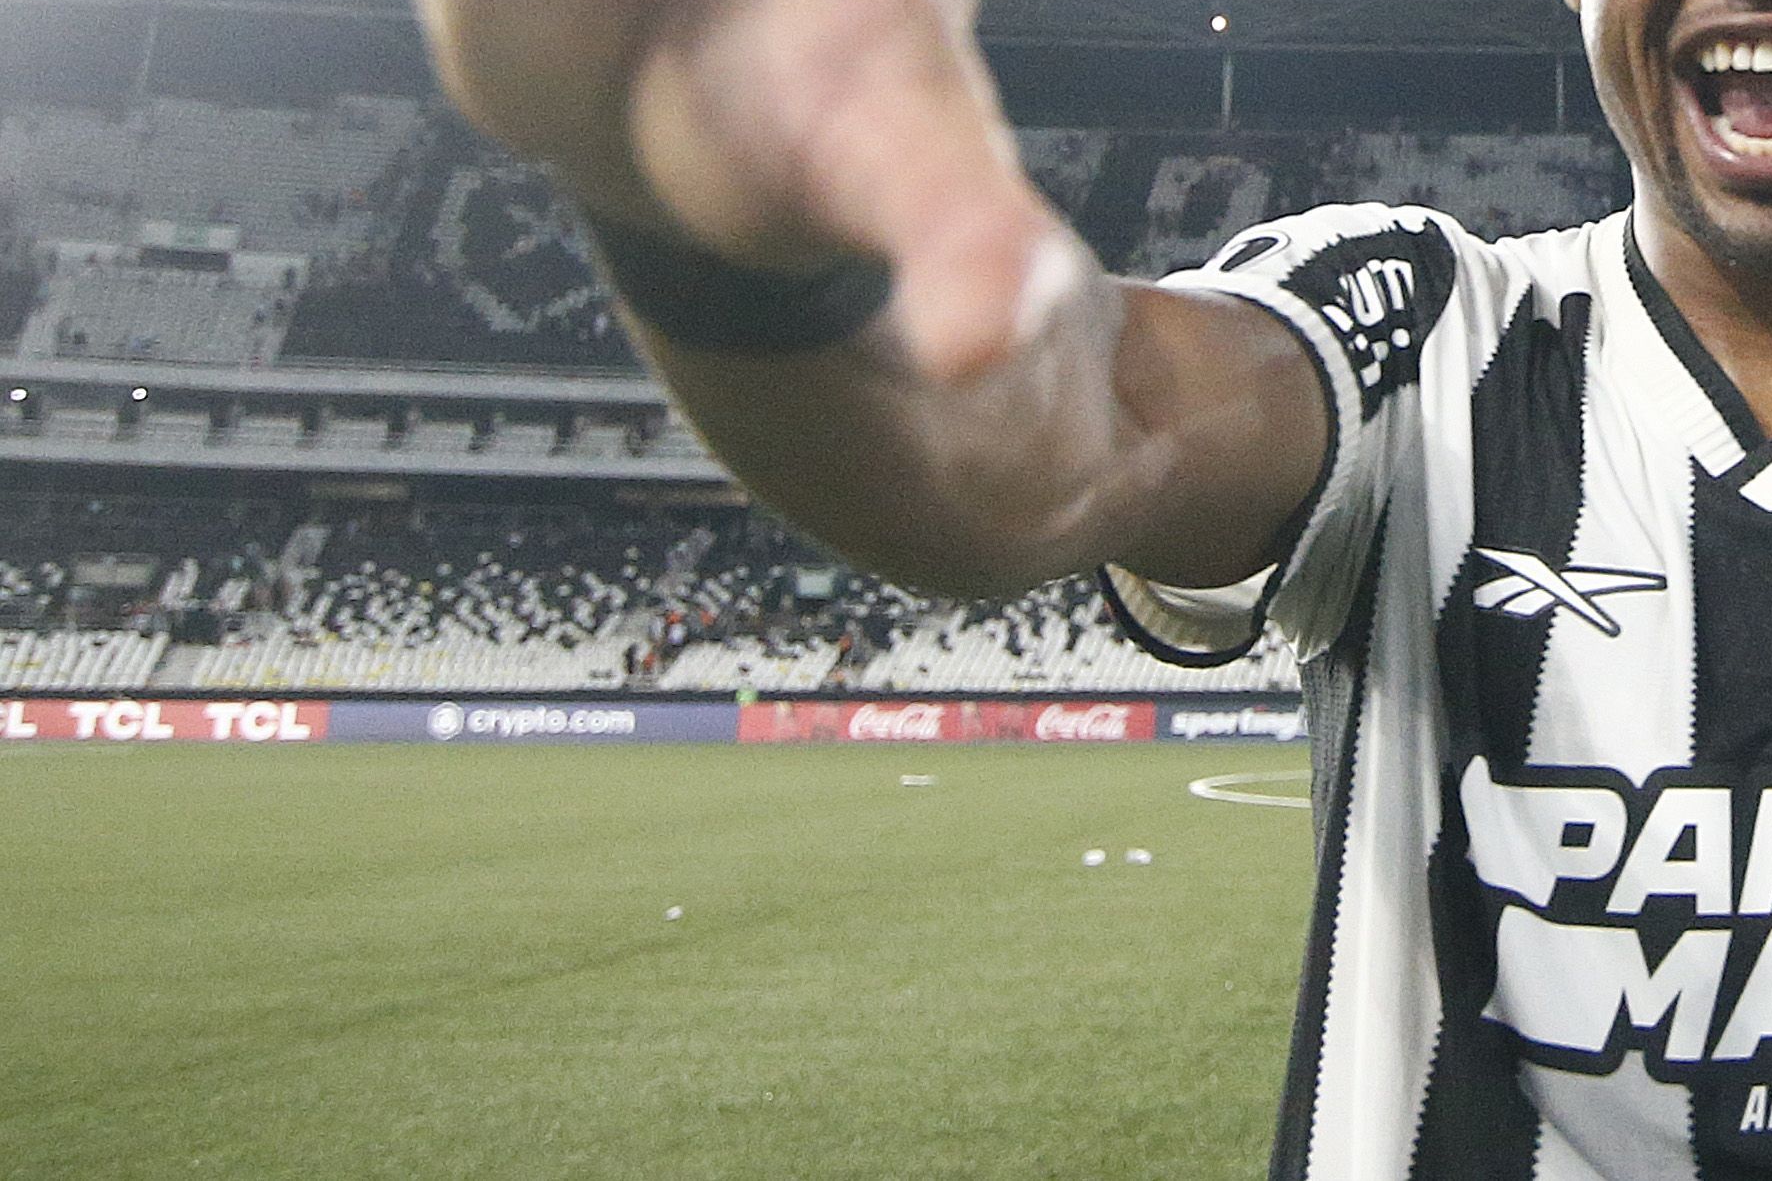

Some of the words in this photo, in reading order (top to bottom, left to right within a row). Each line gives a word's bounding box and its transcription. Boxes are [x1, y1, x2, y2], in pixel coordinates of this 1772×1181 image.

[68, 700, 175, 741] TCL
[203, 700, 312, 741] TCL
[467, 706, 636, 737] crypto.com
